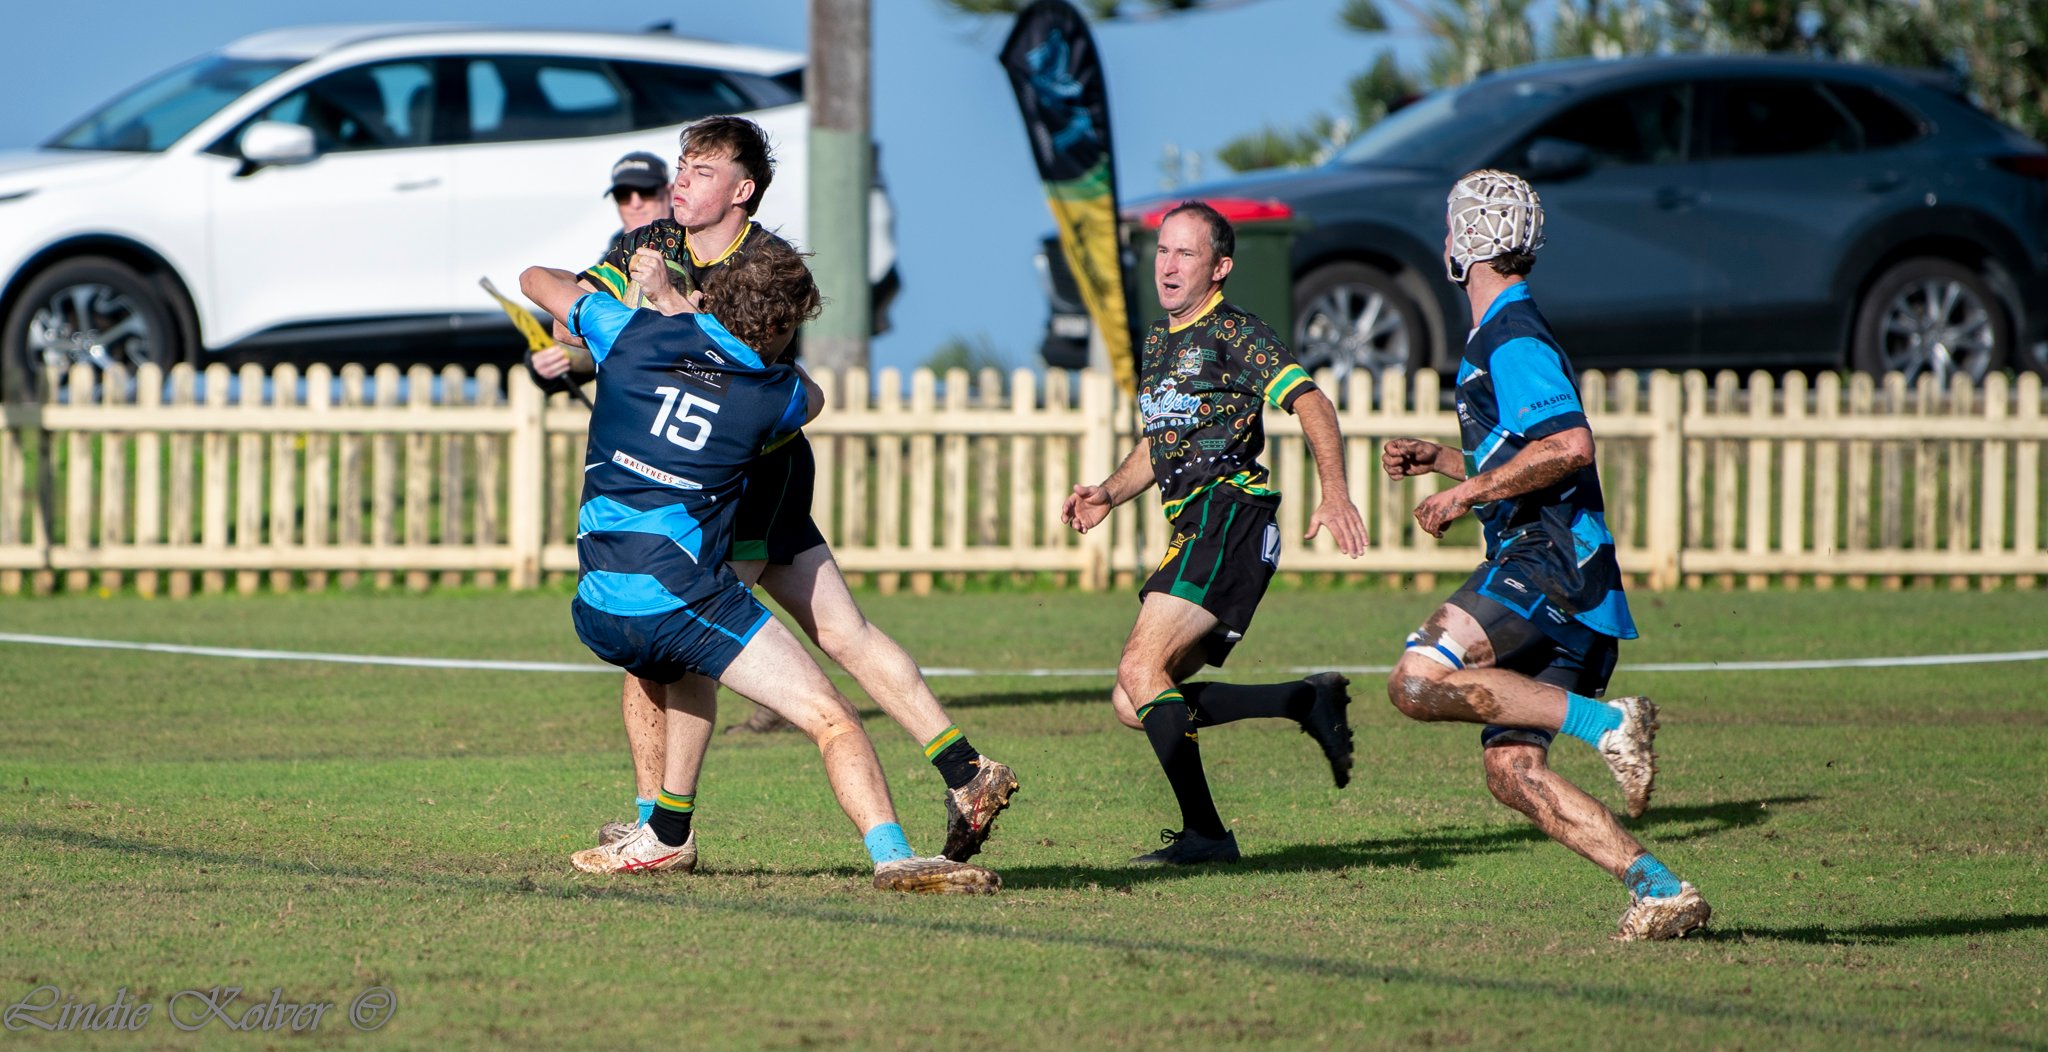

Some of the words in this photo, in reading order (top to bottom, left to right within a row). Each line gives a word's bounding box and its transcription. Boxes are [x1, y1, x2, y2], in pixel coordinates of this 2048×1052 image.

[1161, 388, 1201, 415] City
[1530, 393, 1573, 411] SEASIDE
[650, 386, 720, 451] 15
[623, 457, 674, 484] BALLYNESS
